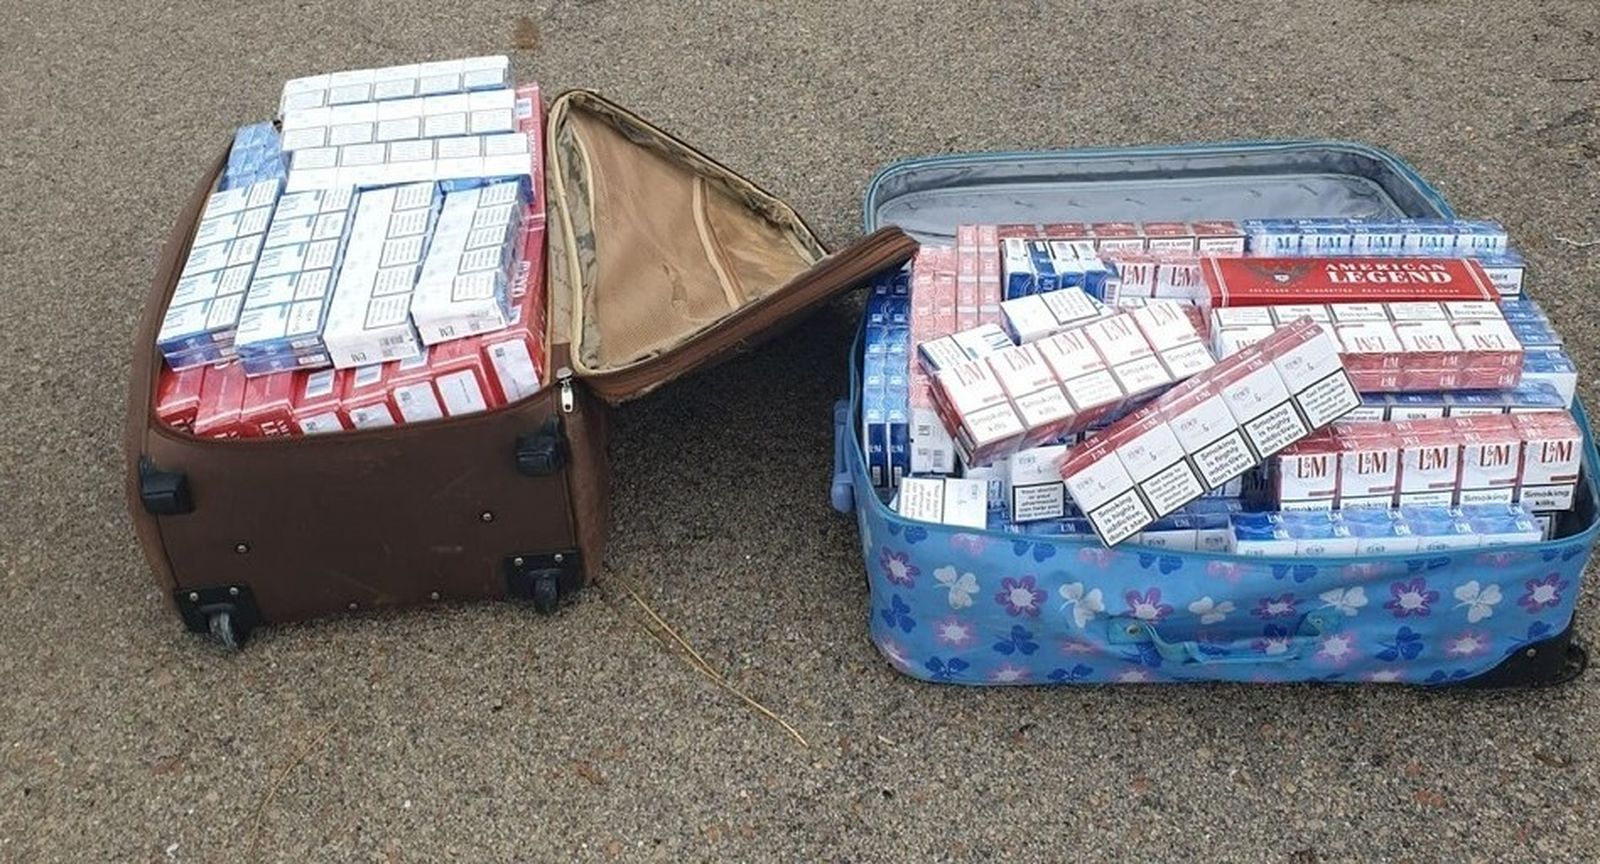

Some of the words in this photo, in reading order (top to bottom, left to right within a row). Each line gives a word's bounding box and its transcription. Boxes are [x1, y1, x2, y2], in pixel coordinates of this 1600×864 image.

[1325, 263, 1446, 271] AMERICAN
[1327, 271, 1452, 283] LEGEND
[1251, 408, 1289, 430] Smoking
[1266, 416, 1290, 432] highly
[1284, 428, 1303, 442] start
[1200, 438, 1236, 461] Smoking
[1214, 446, 1239, 463] highly
[1480, 444, 1511, 468] L&M
[1541, 440, 1573, 464] L&M
[1232, 457, 1252, 472] start
[1358, 451, 1388, 475] L&M
[1419, 447, 1449, 470] L&M
[1297, 456, 1327, 479] L&M
[1464, 494, 1509, 502] Smoking
[1524, 490, 1570, 499] Smoking
[1098, 496, 1133, 518] Smoking
[1111, 504, 1135, 520] highly
[1129, 515, 1149, 530] start
